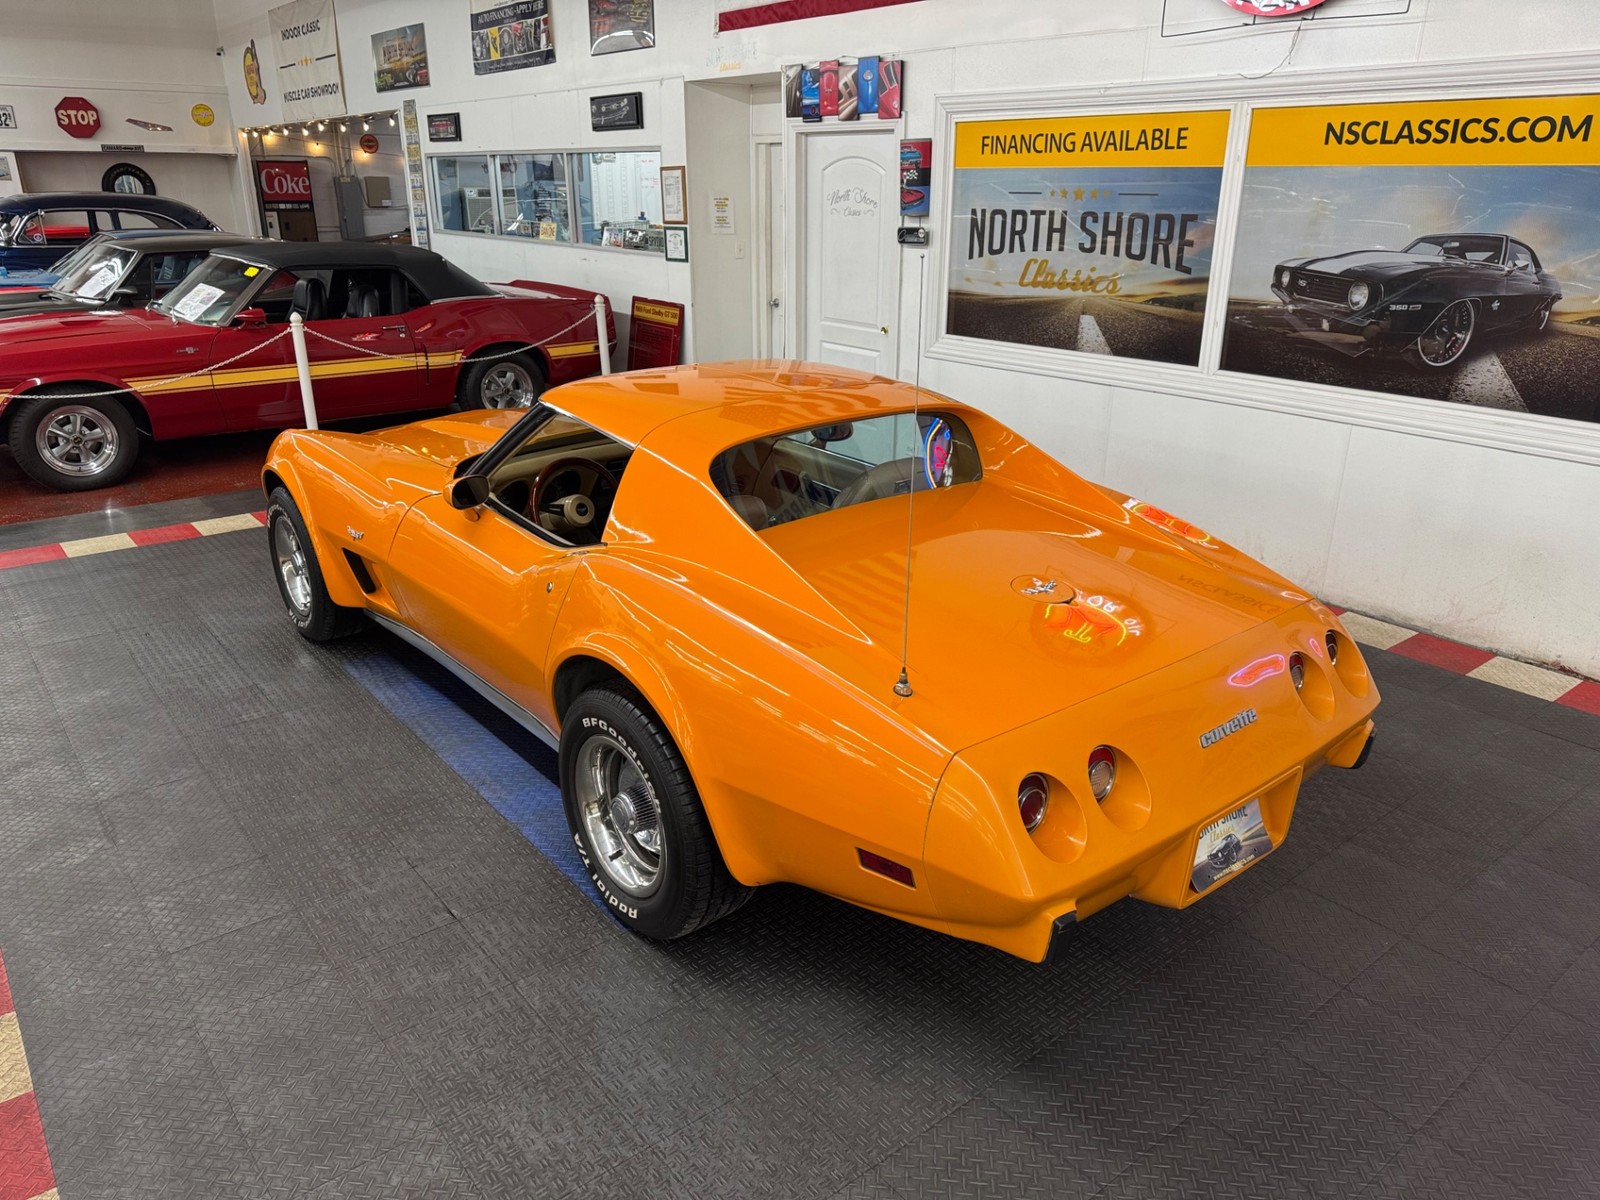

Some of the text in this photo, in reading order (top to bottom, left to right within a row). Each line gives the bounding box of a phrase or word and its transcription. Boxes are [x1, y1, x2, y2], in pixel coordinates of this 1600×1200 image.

[490, 7, 514, 21] FINANCING
[517, 3, 532, 14] APPLY
[532, 0, 544, 9] HERE
[281, 19, 321, 41] INDOOR CLASSIC
[283, 82, 339, 103] MUSCLE CAR SHOWROOM
[57, 109, 98, 126] STOP
[981, 127, 1189, 155] FINANCING AVAILABLE
[1324, 114, 1594, 146] NSCLASSICS.COM
[260, 168, 310, 194] Coke
[968, 208, 1199, 275] NORTH SHORE
[1018, 258, 1122, 294] Classics
[642, 306, 652, 314] Ford
[651, 307, 664, 318] Shelby
[664, 310, 671, 318] GT
